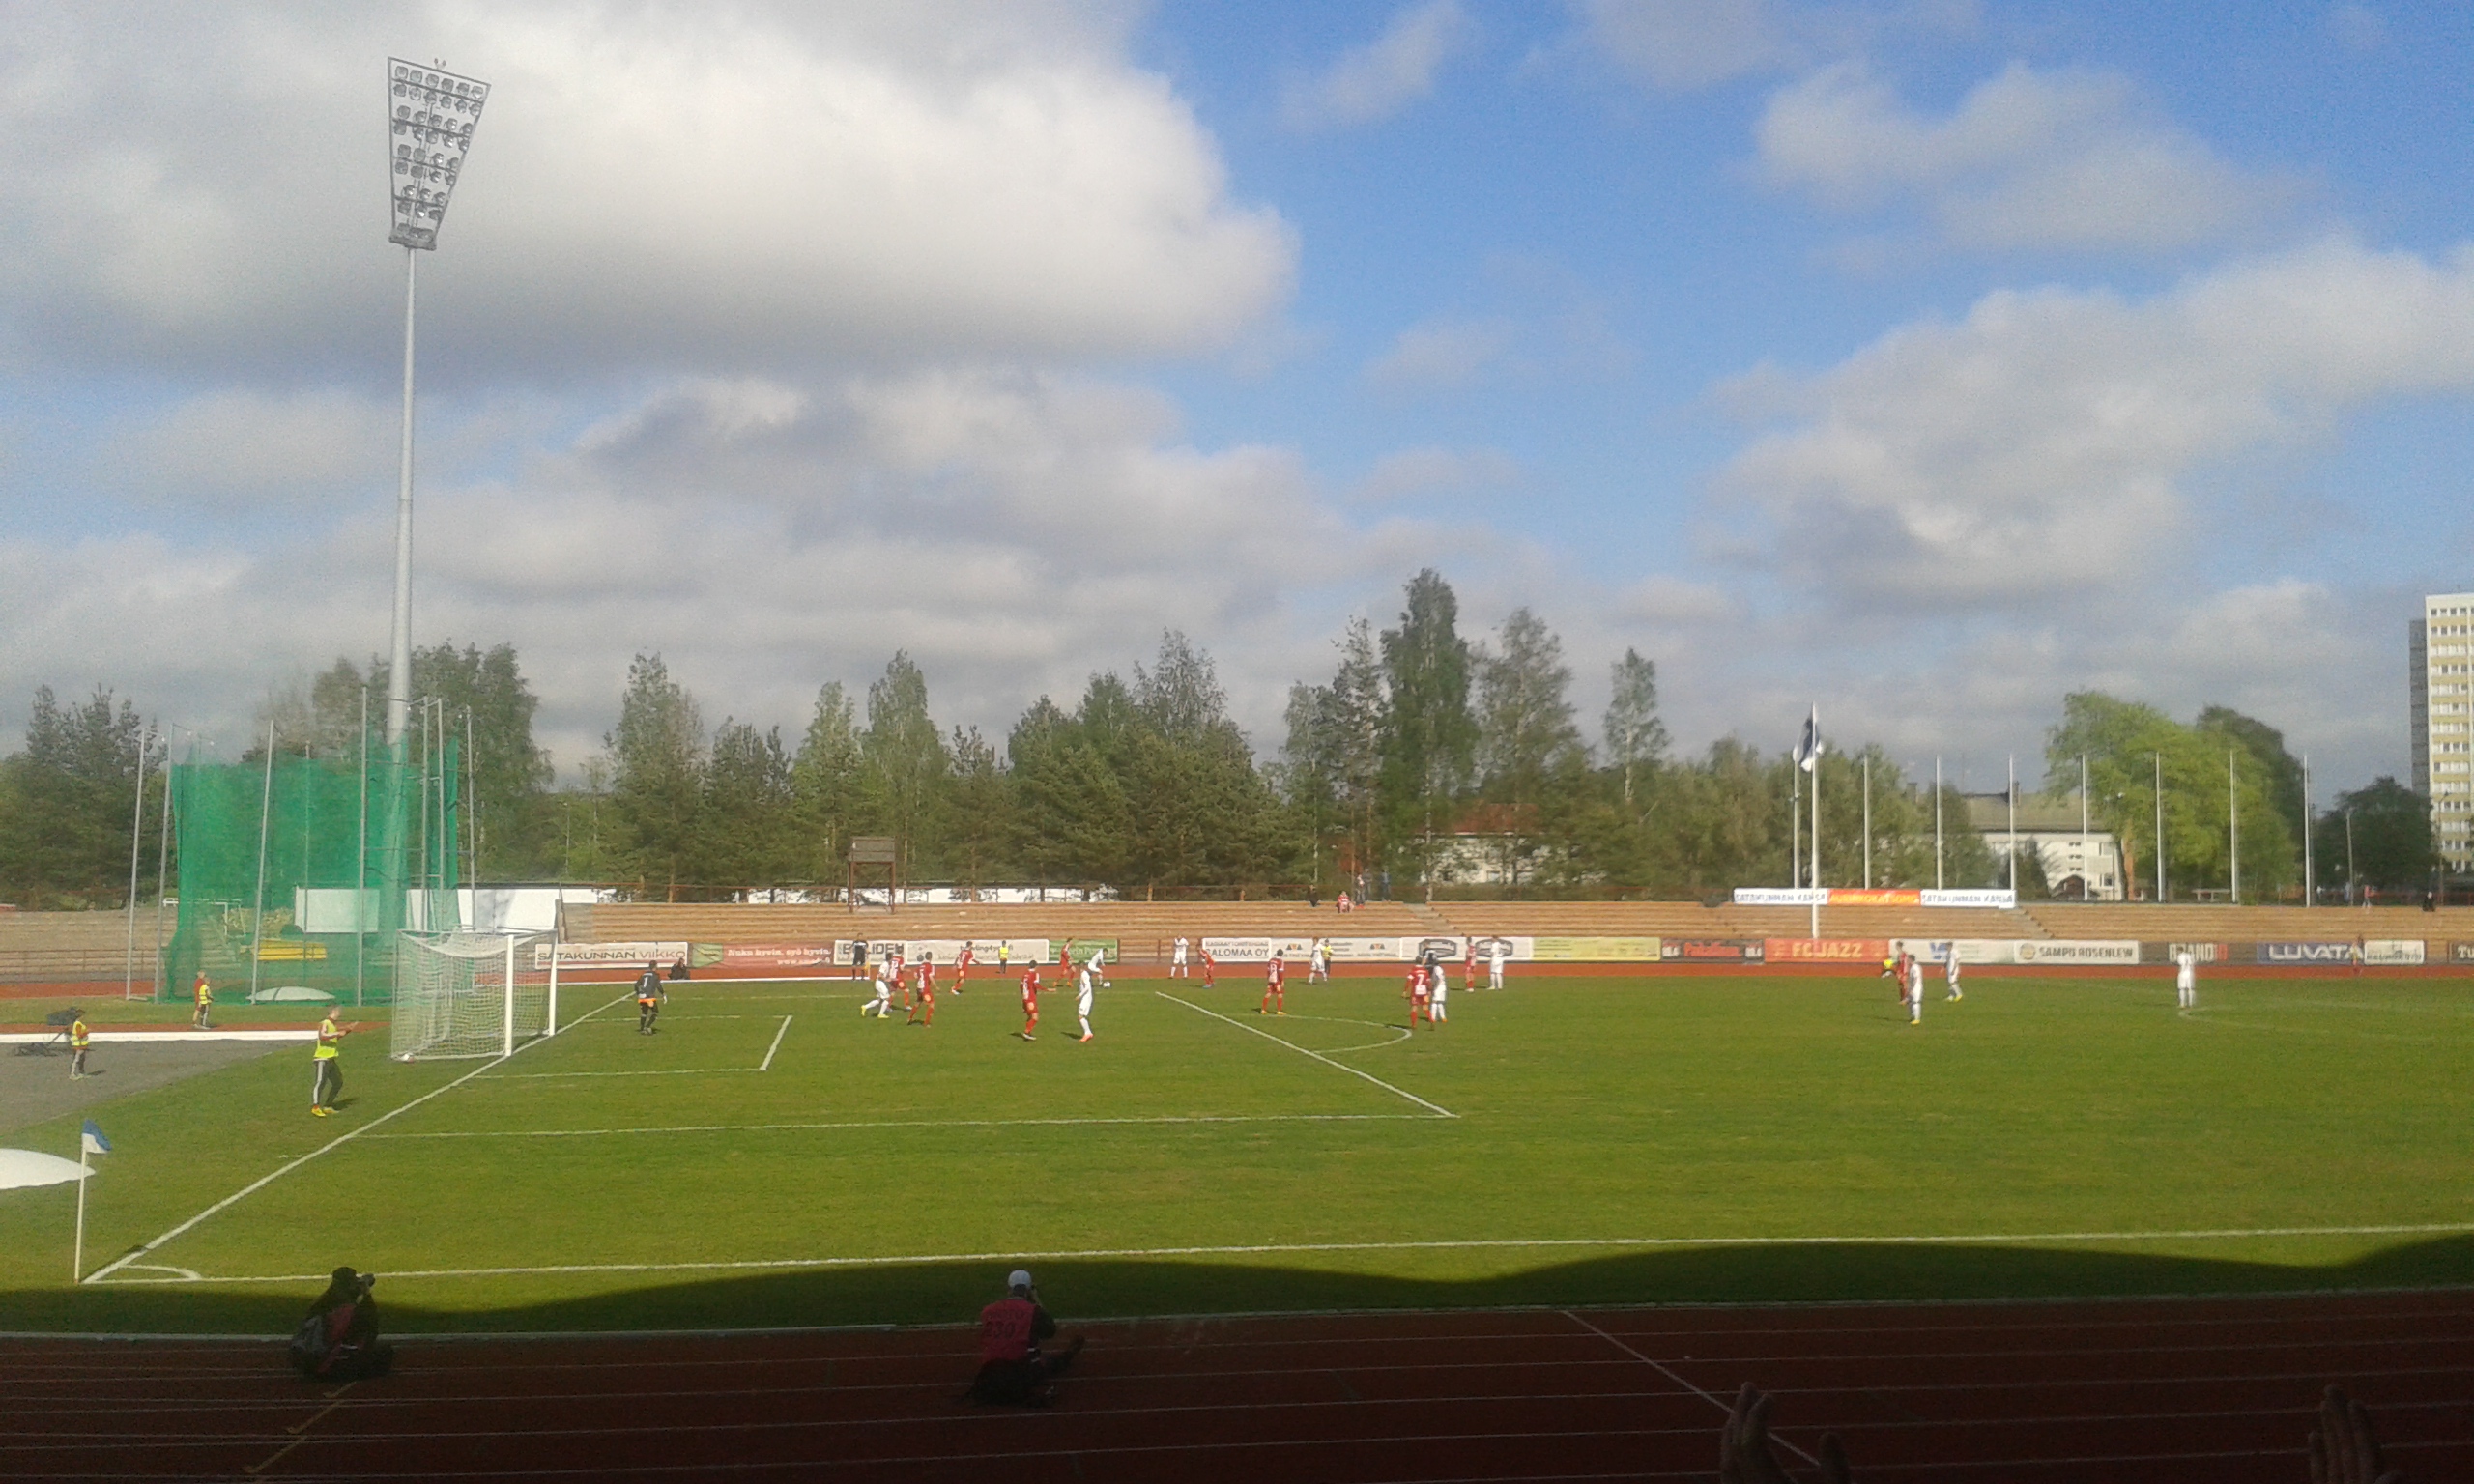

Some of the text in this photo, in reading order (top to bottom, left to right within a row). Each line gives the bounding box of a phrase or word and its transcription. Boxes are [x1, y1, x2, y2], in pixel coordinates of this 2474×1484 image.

[842, 943, 904, 955] BIDEN
[1816, 942, 1863, 958] JAZZ
[2268, 944, 2364, 960] LUVATA
[537, 950, 686, 961] SATAKUNNAN VIIKKO
[643, 976, 648, 988] 1
